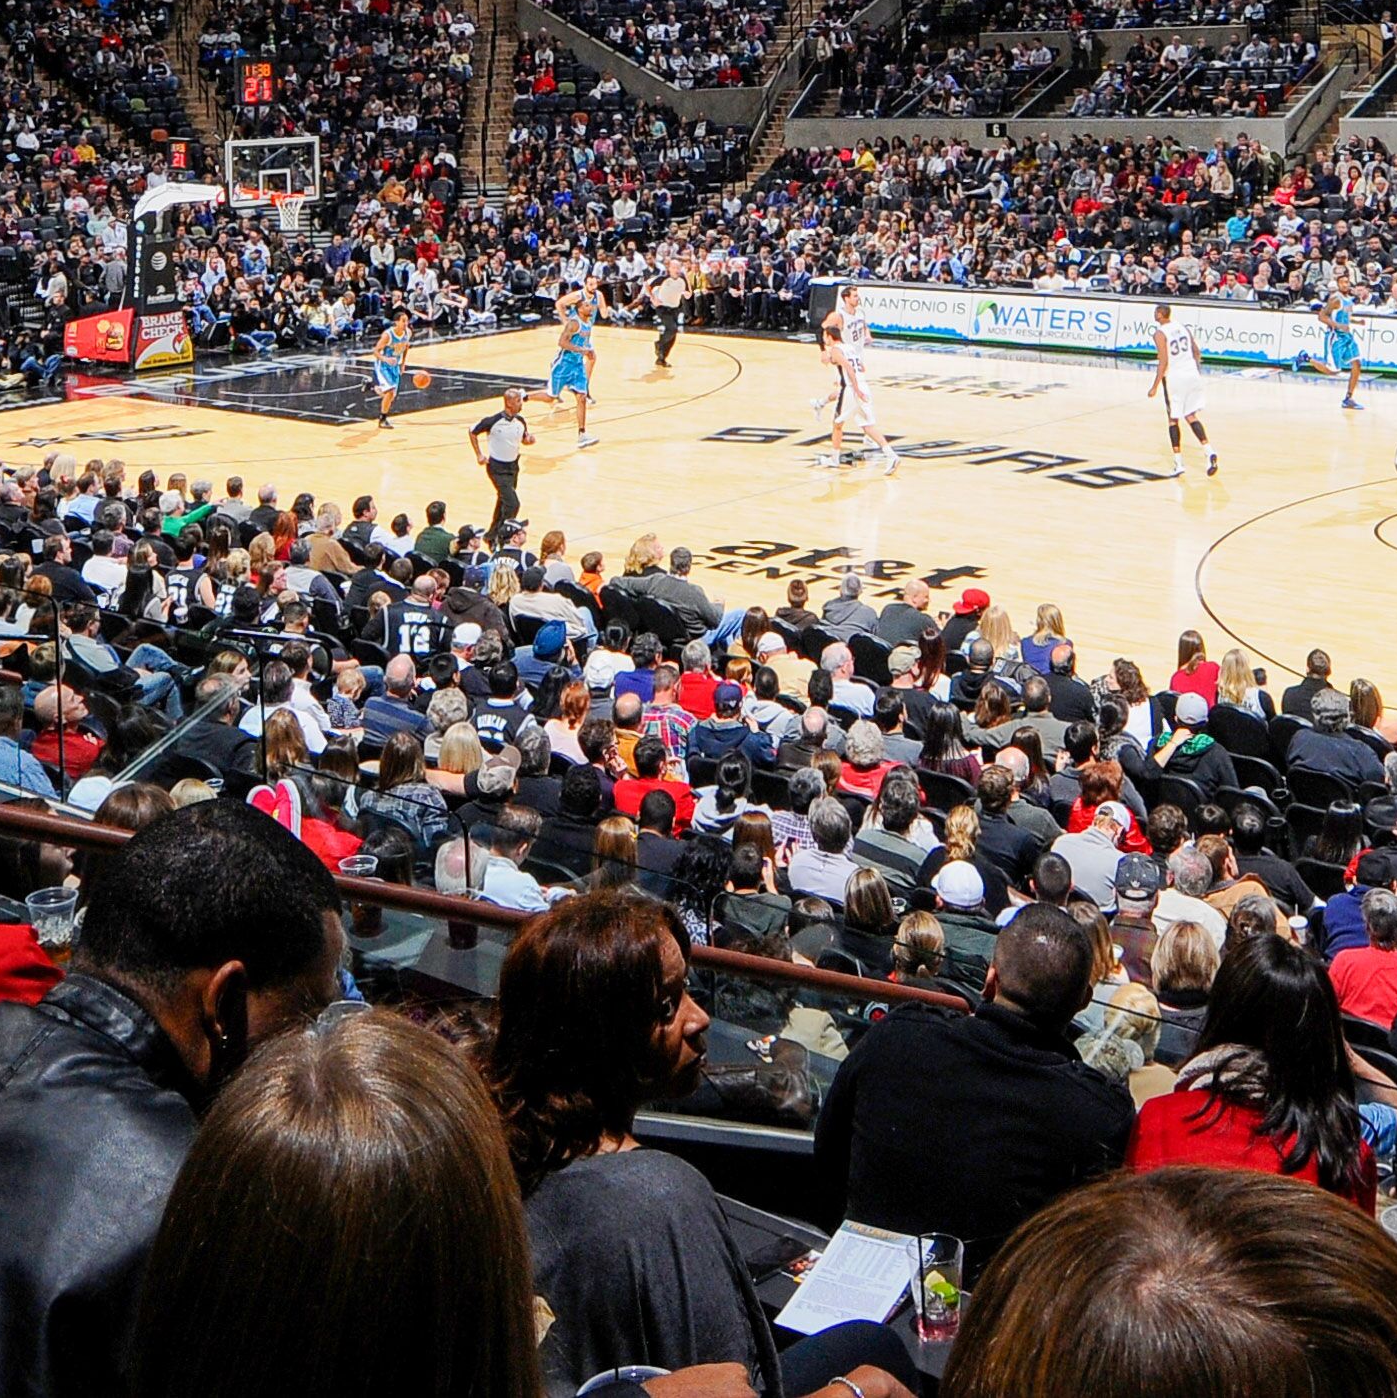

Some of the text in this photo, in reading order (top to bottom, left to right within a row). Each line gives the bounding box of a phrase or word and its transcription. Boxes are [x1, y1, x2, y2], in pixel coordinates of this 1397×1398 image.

[992, 123, 1001, 137] 6
[878, 296, 967, 316] ANTONIO IS
[141, 311, 183, 328] BRAKE
[993, 305, 1113, 334] WATER'S
[142, 324, 184, 340] CHECK
[987, 326, 1111, 343] MOST RESOURCEFUL CITY
[1169, 336, 1190, 356] 33
[399, 624, 431, 654] 12
